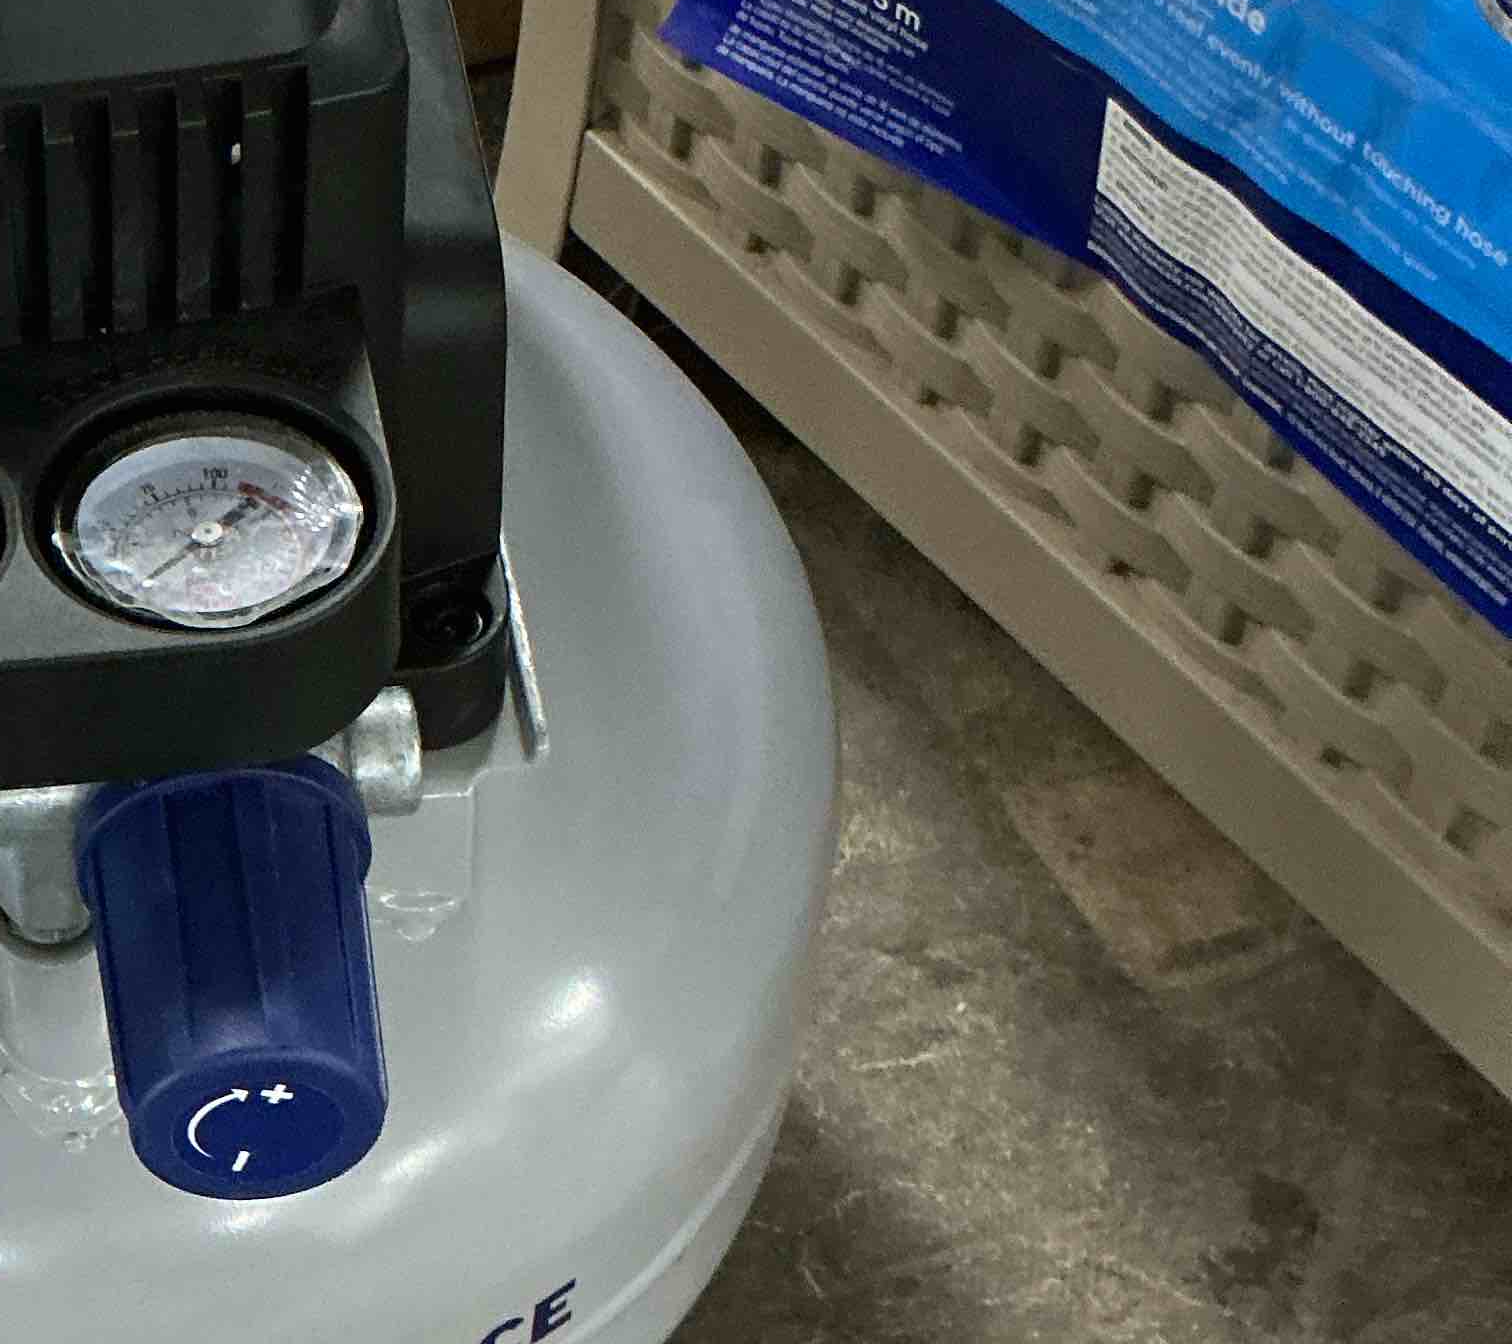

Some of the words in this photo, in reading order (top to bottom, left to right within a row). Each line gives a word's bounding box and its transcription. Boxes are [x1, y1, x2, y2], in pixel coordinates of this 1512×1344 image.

[894, 3, 922, 33] m
[1207, 34, 1274, 89] evenly
[1278, 80, 1356, 149] without
[1361, 140, 1452, 228] touching
[1453, 214, 1509, 269] hose
